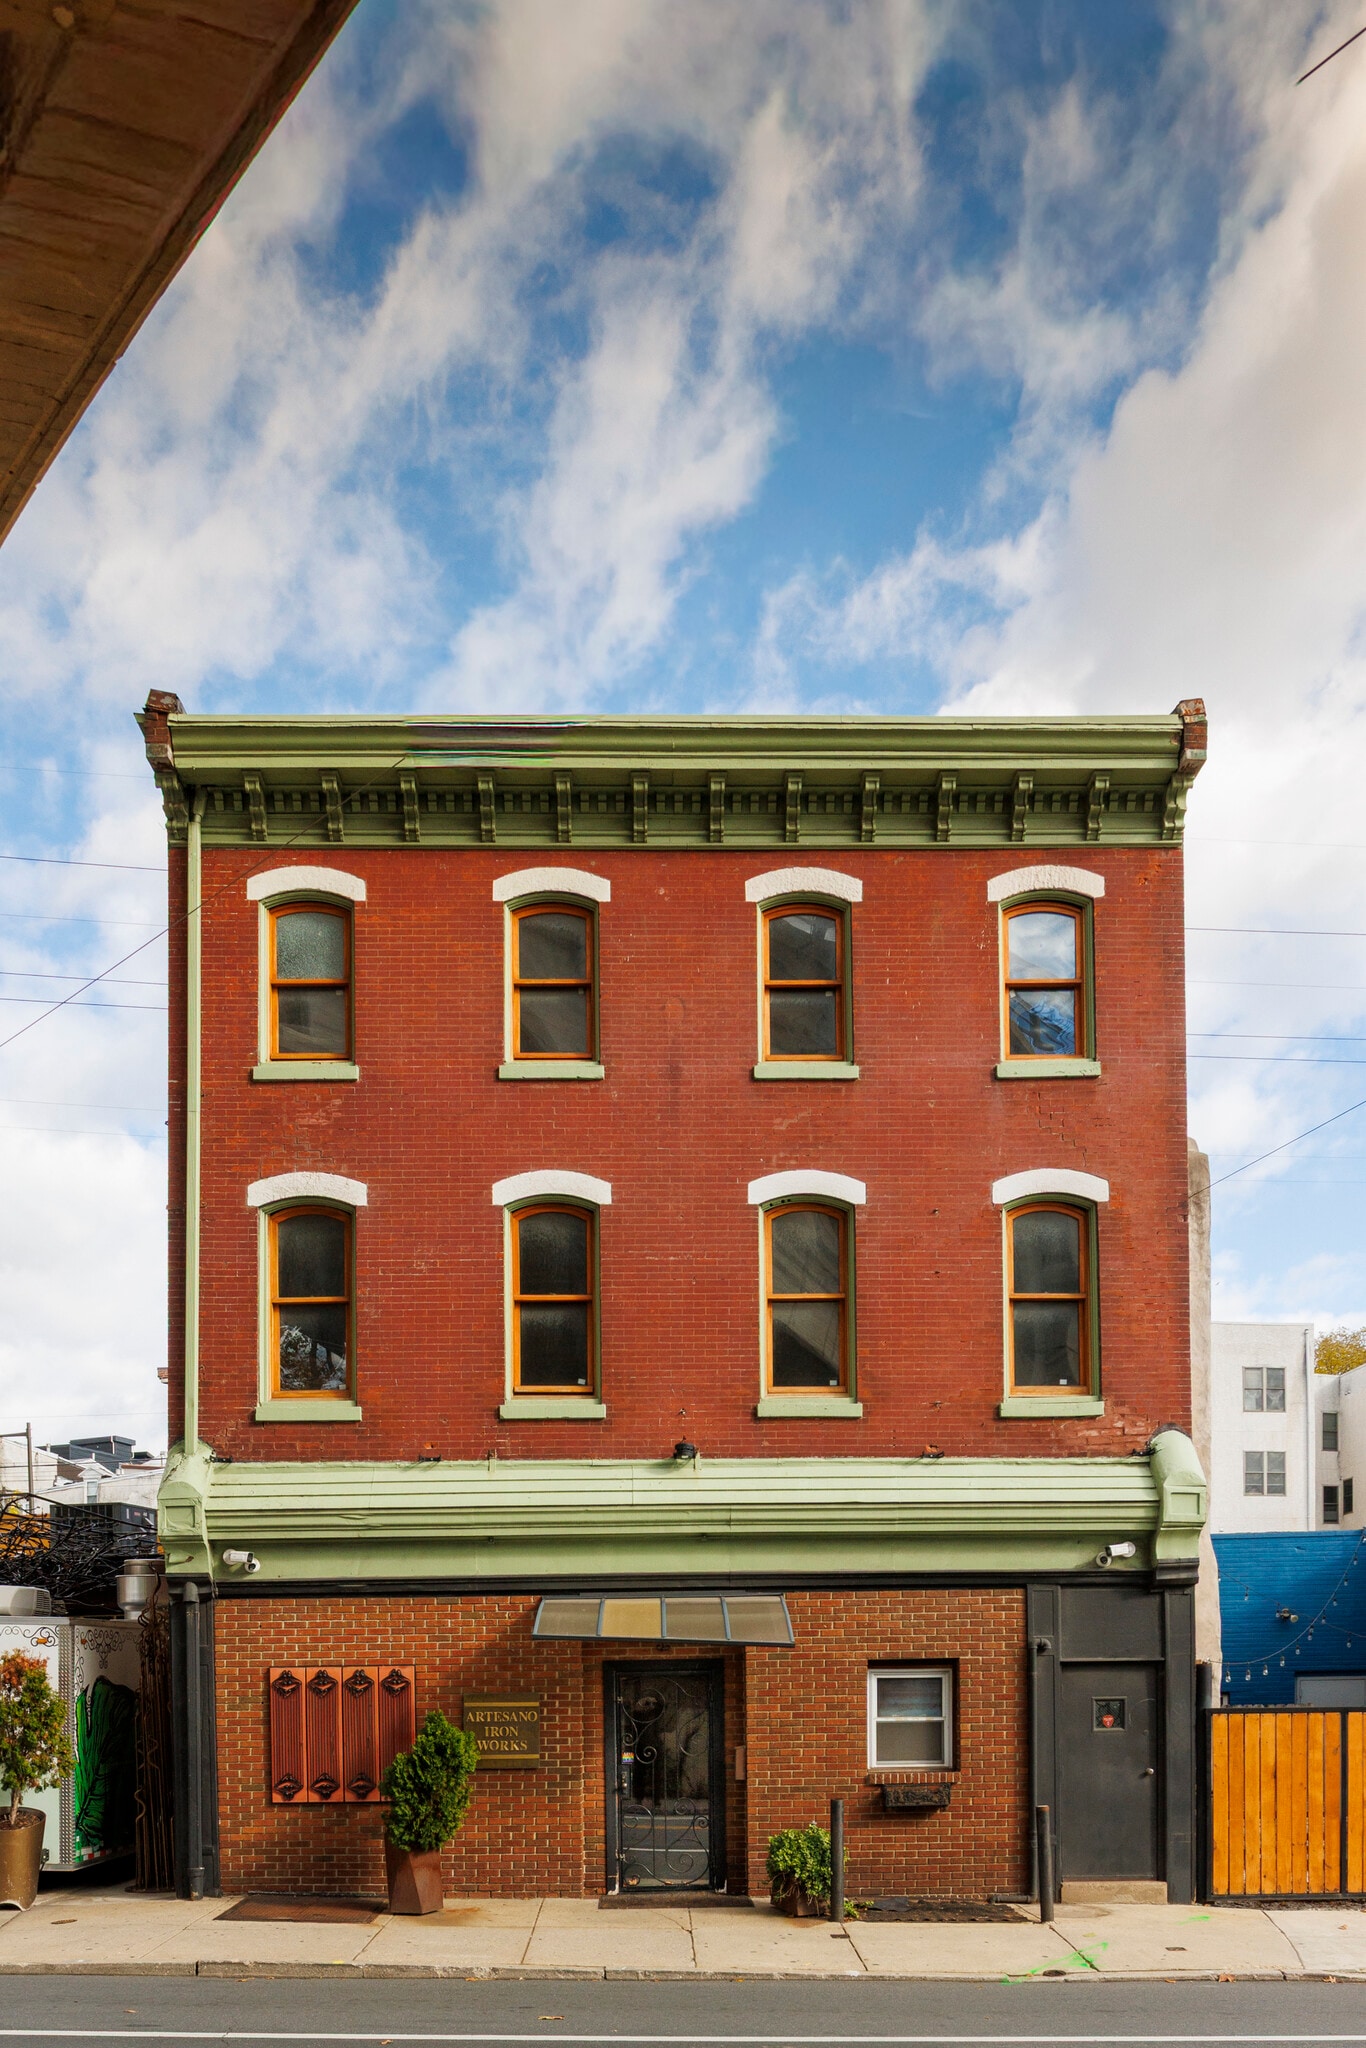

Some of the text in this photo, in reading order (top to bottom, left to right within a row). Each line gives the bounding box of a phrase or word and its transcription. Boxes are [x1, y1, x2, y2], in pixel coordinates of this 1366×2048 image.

[467, 1711, 537, 1722] ARTESANO
[484, 1726, 518, 1737] IRON
[477, 1740, 527, 1751] WORKS
